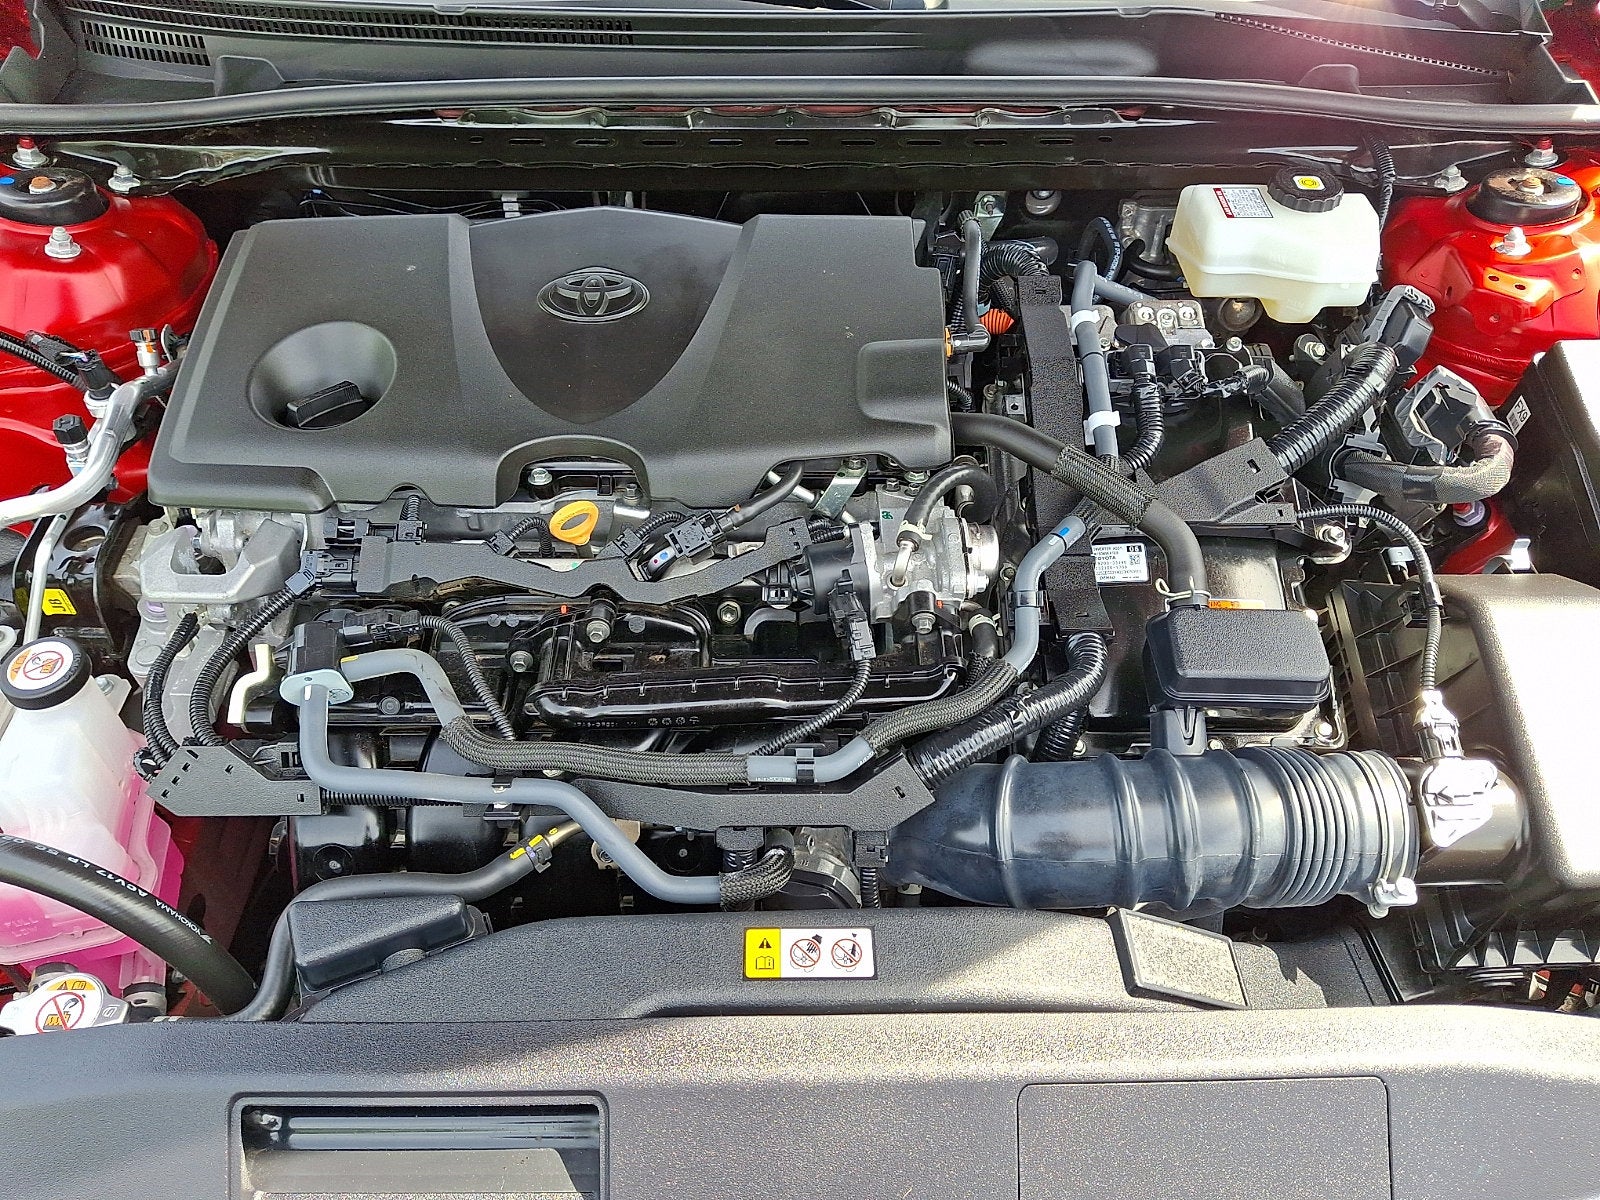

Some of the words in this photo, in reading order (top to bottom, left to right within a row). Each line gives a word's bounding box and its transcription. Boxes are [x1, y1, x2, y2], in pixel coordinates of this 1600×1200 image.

[1514, 399, 1528, 423] FX9
[67, 856, 91, 869] LP
[155, 898, 202, 936] YOKOHAMA
